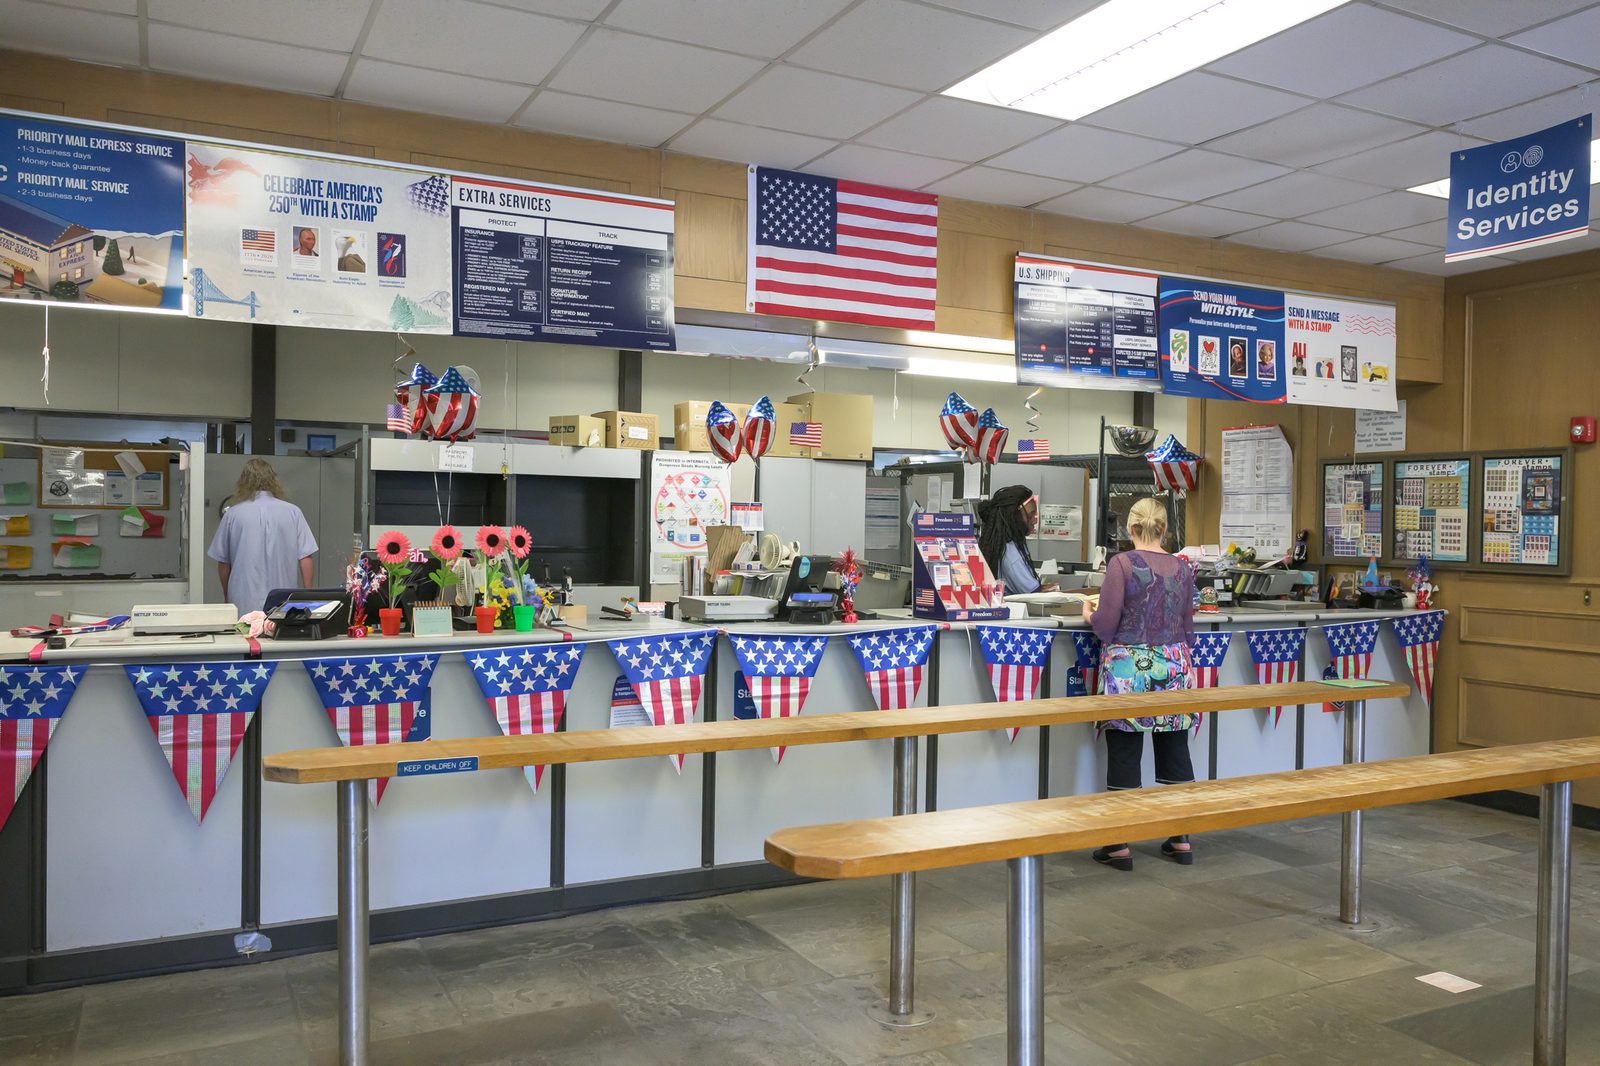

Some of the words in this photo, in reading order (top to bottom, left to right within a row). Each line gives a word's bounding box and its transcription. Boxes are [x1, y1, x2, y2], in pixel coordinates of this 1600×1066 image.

[18, 128, 63, 145] PRIORITY
[65, 135, 89, 148] MAIL
[90, 138, 132, 153] EXPRESS
[136, 143, 173, 158] SERVICE
[22, 145, 35, 153] 1-3
[36, 147, 71, 158] business
[73, 151, 92, 161] days
[22, 156, 71, 169] Money-back
[72, 163, 111, 173] guarantee
[18, 171, 63, 187] PRIORITY
[65, 178, 89, 191] MAIL
[91, 180, 129, 194] SERVICE
[264, 174, 323, 198] CELEBRATE
[326, 183, 383, 204] AMERICA'S
[1467, 168, 1574, 211] Identity
[22, 188, 36, 196] 2-3
[38, 190, 73, 200] business
[74, 194, 93, 202] days
[459, 187, 496, 205] EXTRA
[499, 192, 551, 212] SERVICES
[299, 198, 328, 218] WITH
[331, 204, 338, 219] A
[341, 204, 378, 222] STAMP
[488, 218, 517, 227] PROTECT
[1457, 198, 1579, 240] Services
[464, 228, 495, 236] INSURANCE
[592, 243, 613, 251] FEATURE
[1019, 266, 1033, 279] U.S.
[1035, 268, 1070, 283] SHIPPING
[464, 283, 496, 292] REGISTERED
[1192, 290, 1208, 301] SEND
[1208, 292, 1223, 304] YOUR
[1223, 294, 1238, 306] MAIL
[1201, 302, 1225, 316] WITH
[1225, 306, 1255, 318] STYLE
[1288, 306, 1305, 318] SEND
[1305, 309, 1310, 319] A
[1311, 310, 1340, 322] MESSAGE
[1288, 319, 1304, 330] WITH
[1305, 321, 1310, 330] A
[1310, 321, 1332, 333] STAMP
[1292, 342, 1307, 358] ALI
[1407, 463, 1447, 471] FOREVER
[1497, 458, 1543, 466] FOREVER
[403, 764, 421, 772] KEEP
[424, 761, 456, 771] CHILDREN
[459, 760, 472, 769] OFF
